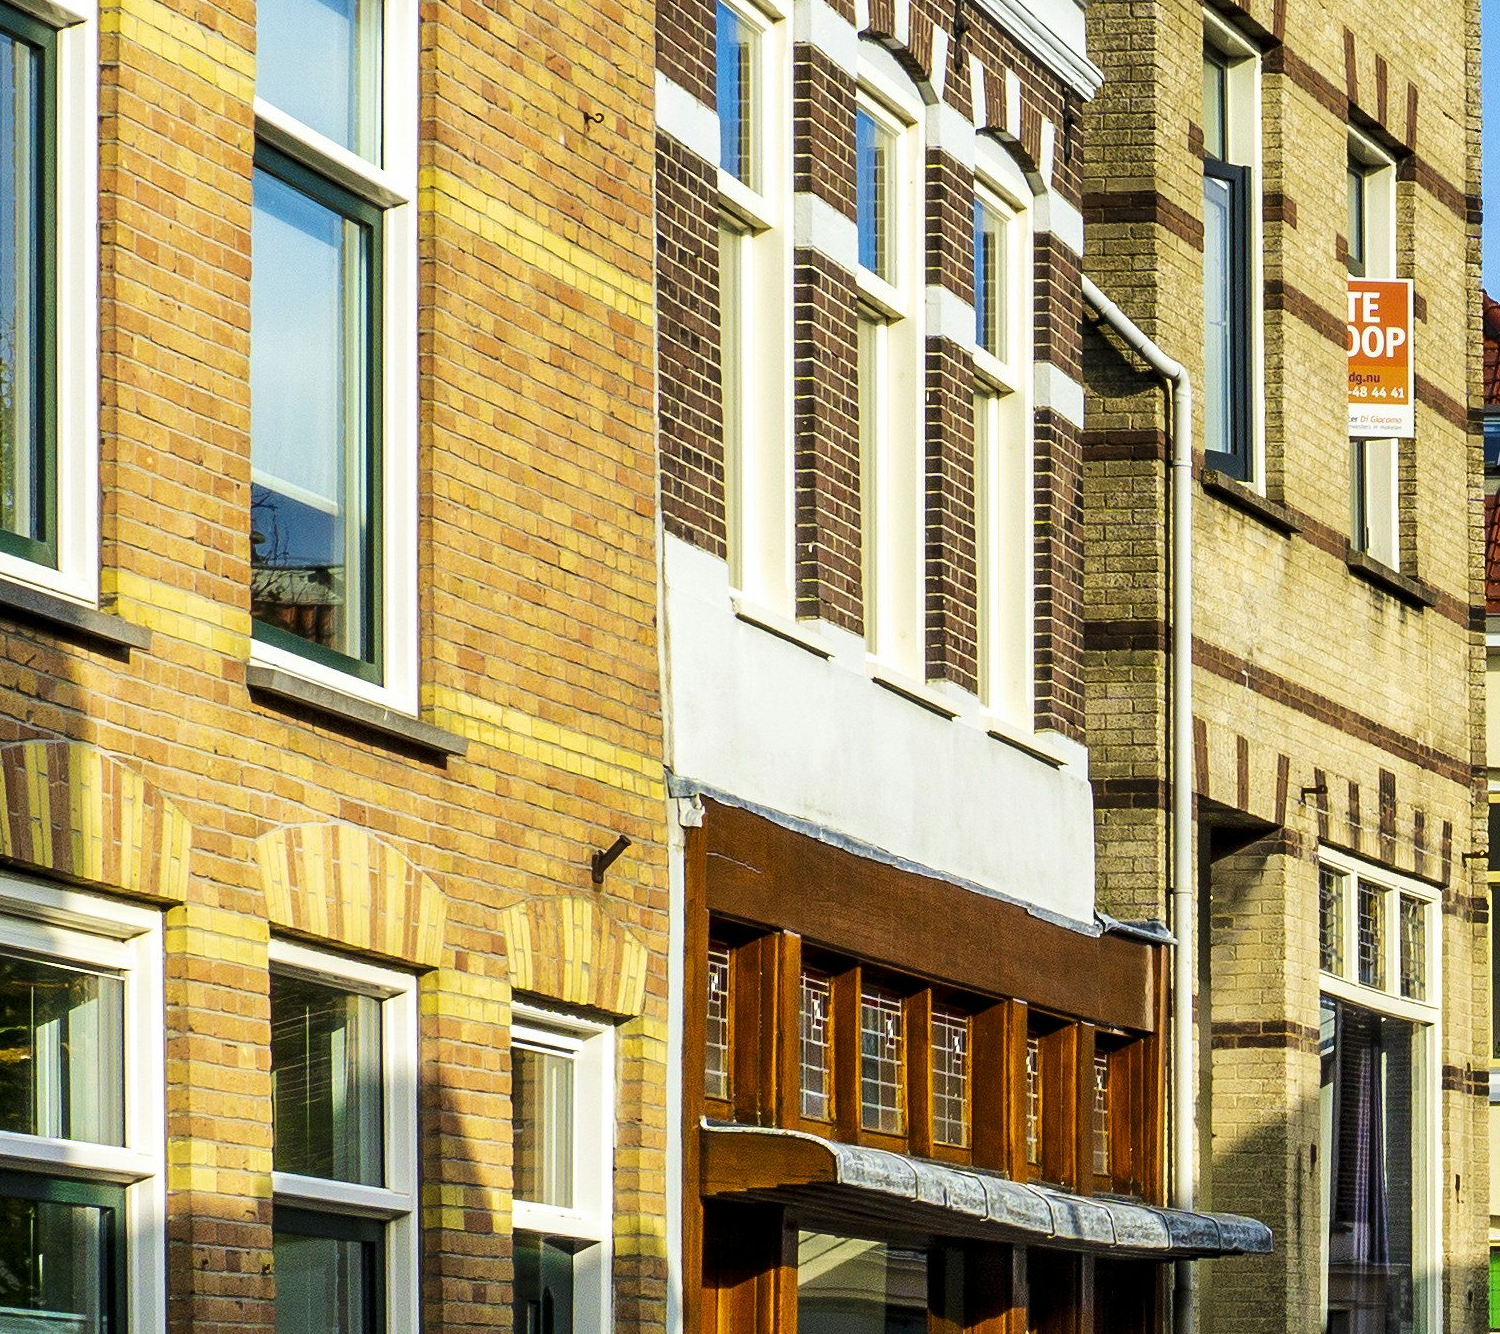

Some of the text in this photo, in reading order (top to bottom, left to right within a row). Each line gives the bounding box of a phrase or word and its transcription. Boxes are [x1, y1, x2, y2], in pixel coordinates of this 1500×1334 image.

[1348, 292, 1381, 323] TE
[1347, 325, 1406, 358] OOP
[1348, 371, 1381, 385] dg.nu
[1348, 385, 1405, 399] -48 44 41
